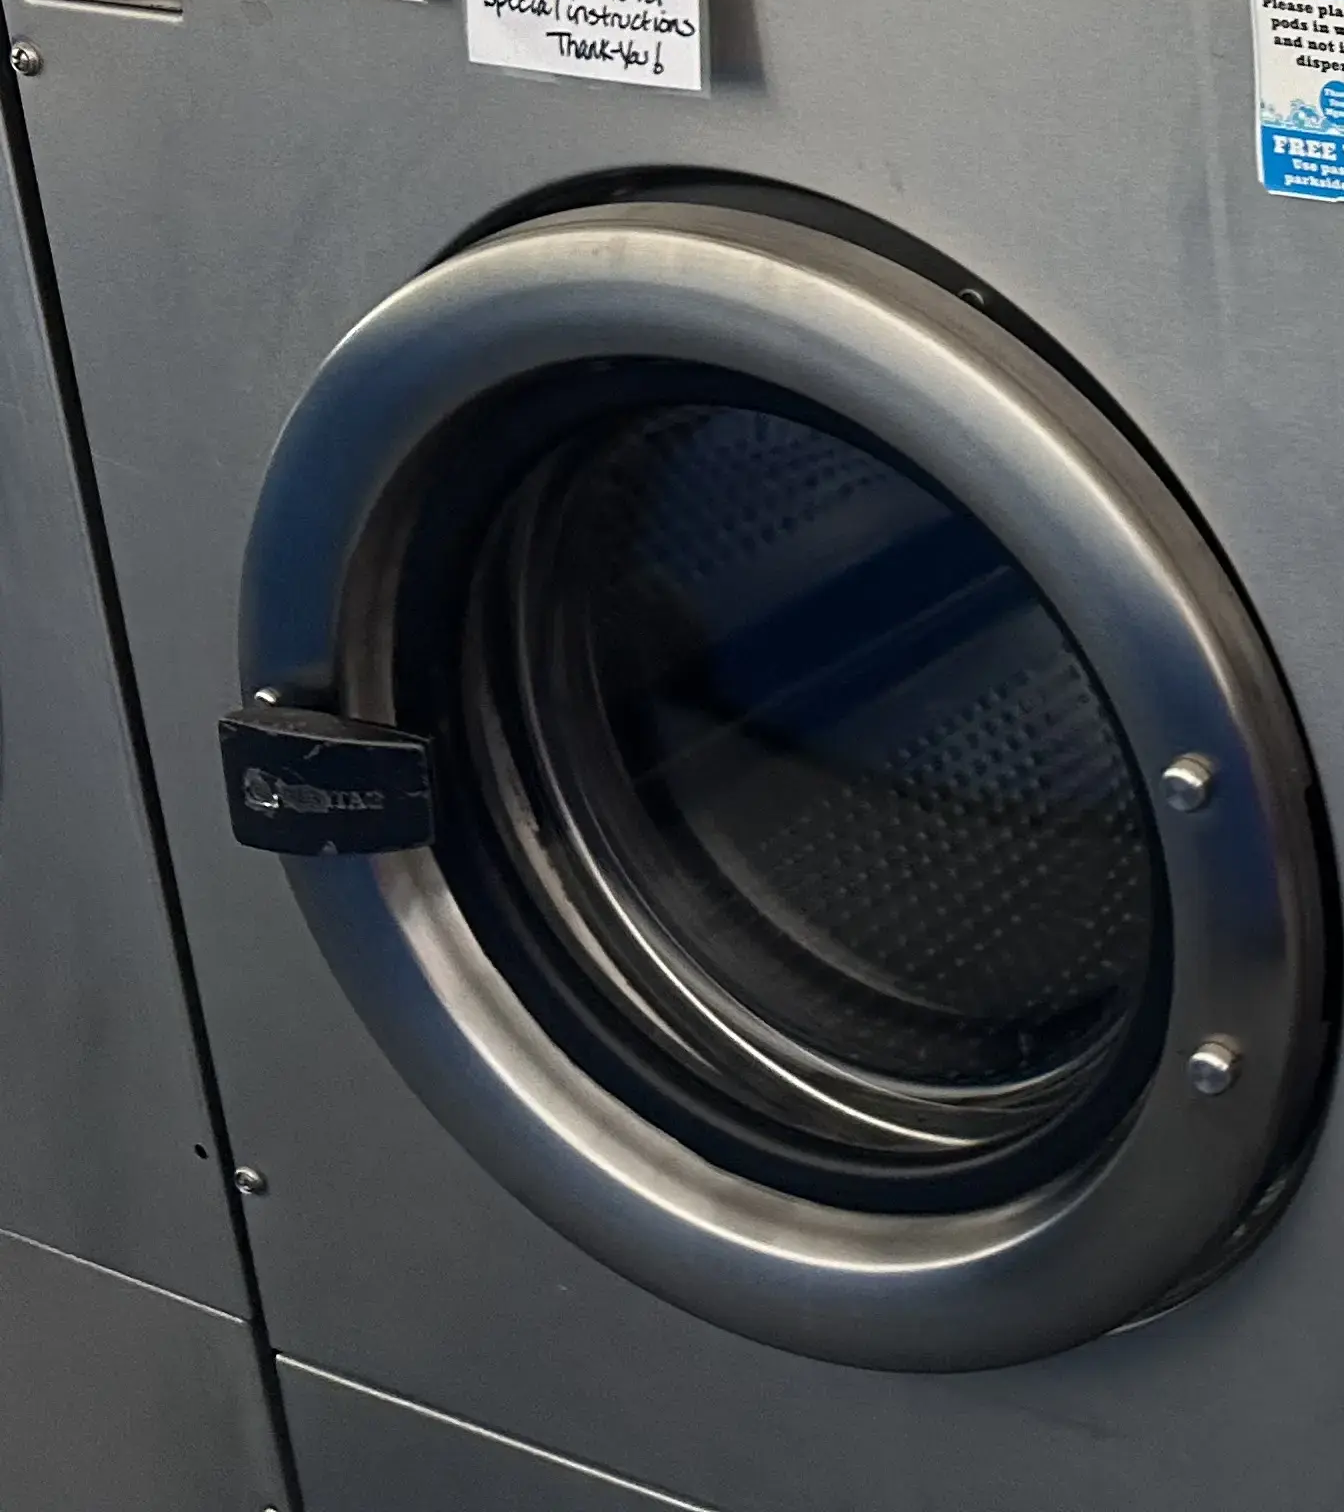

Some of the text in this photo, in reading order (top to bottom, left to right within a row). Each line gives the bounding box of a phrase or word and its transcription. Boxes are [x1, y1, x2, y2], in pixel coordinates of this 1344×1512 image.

[1271, 17, 1309, 31] pods
[1313, 21, 1330, 34] in
[1274, 35, 1302, 49] and
[1307, 41, 1335, 54] not
[1273, 135, 1337, 161] FREE
[1293, 158, 1317, 172] Use
